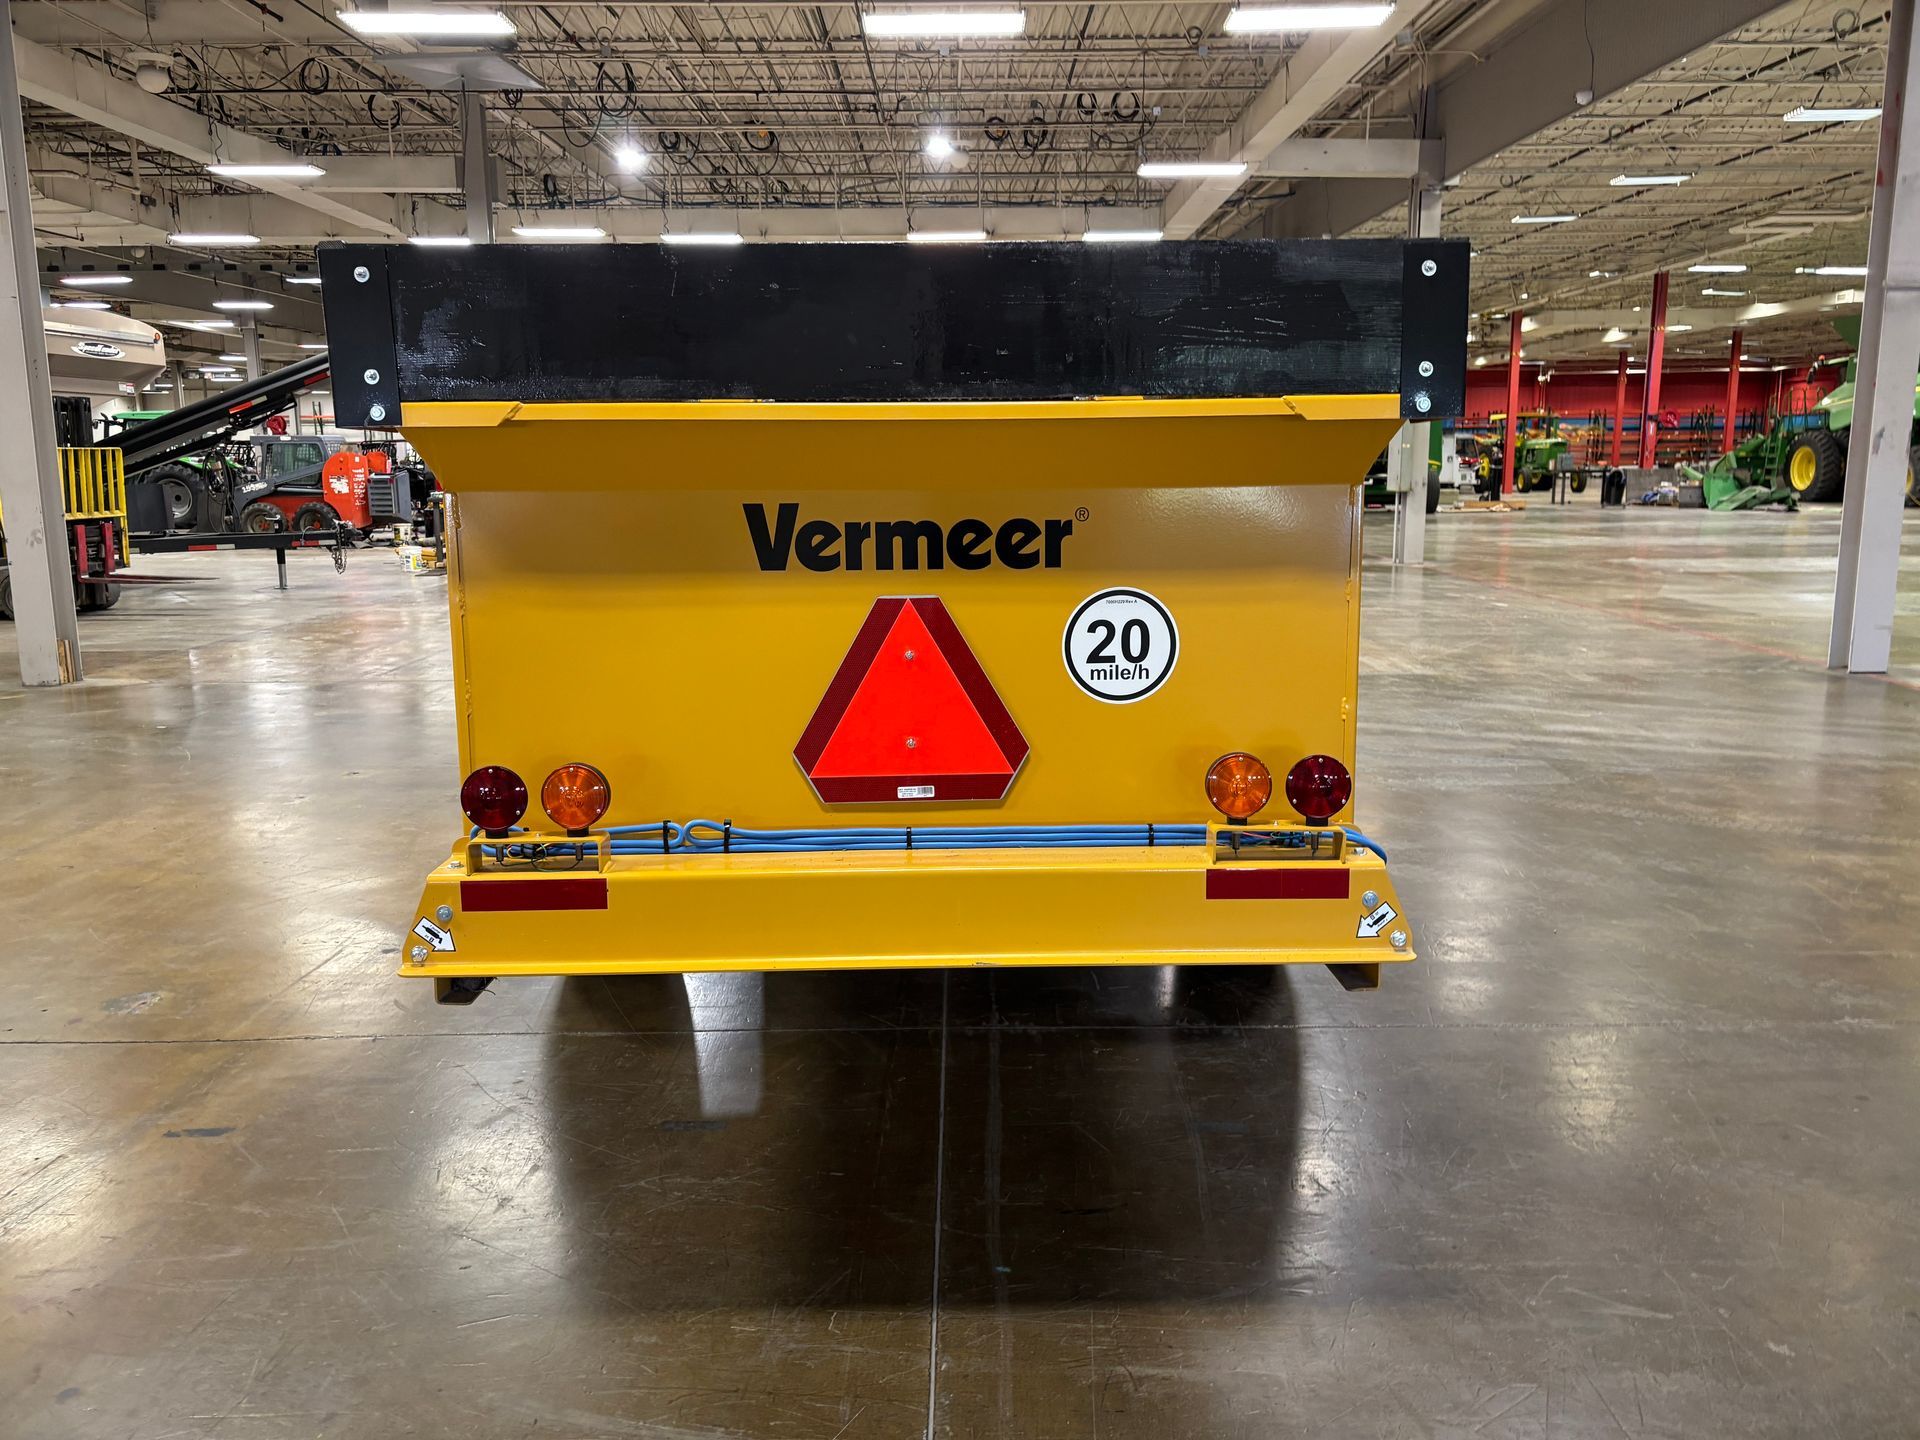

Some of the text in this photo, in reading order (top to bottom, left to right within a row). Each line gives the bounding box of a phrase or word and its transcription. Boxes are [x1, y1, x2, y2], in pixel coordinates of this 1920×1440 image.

[742, 502, 1073, 572] Vermeer
[1086, 618, 1150, 664] 20
[1090, 663, 1150, 681] mile/h
